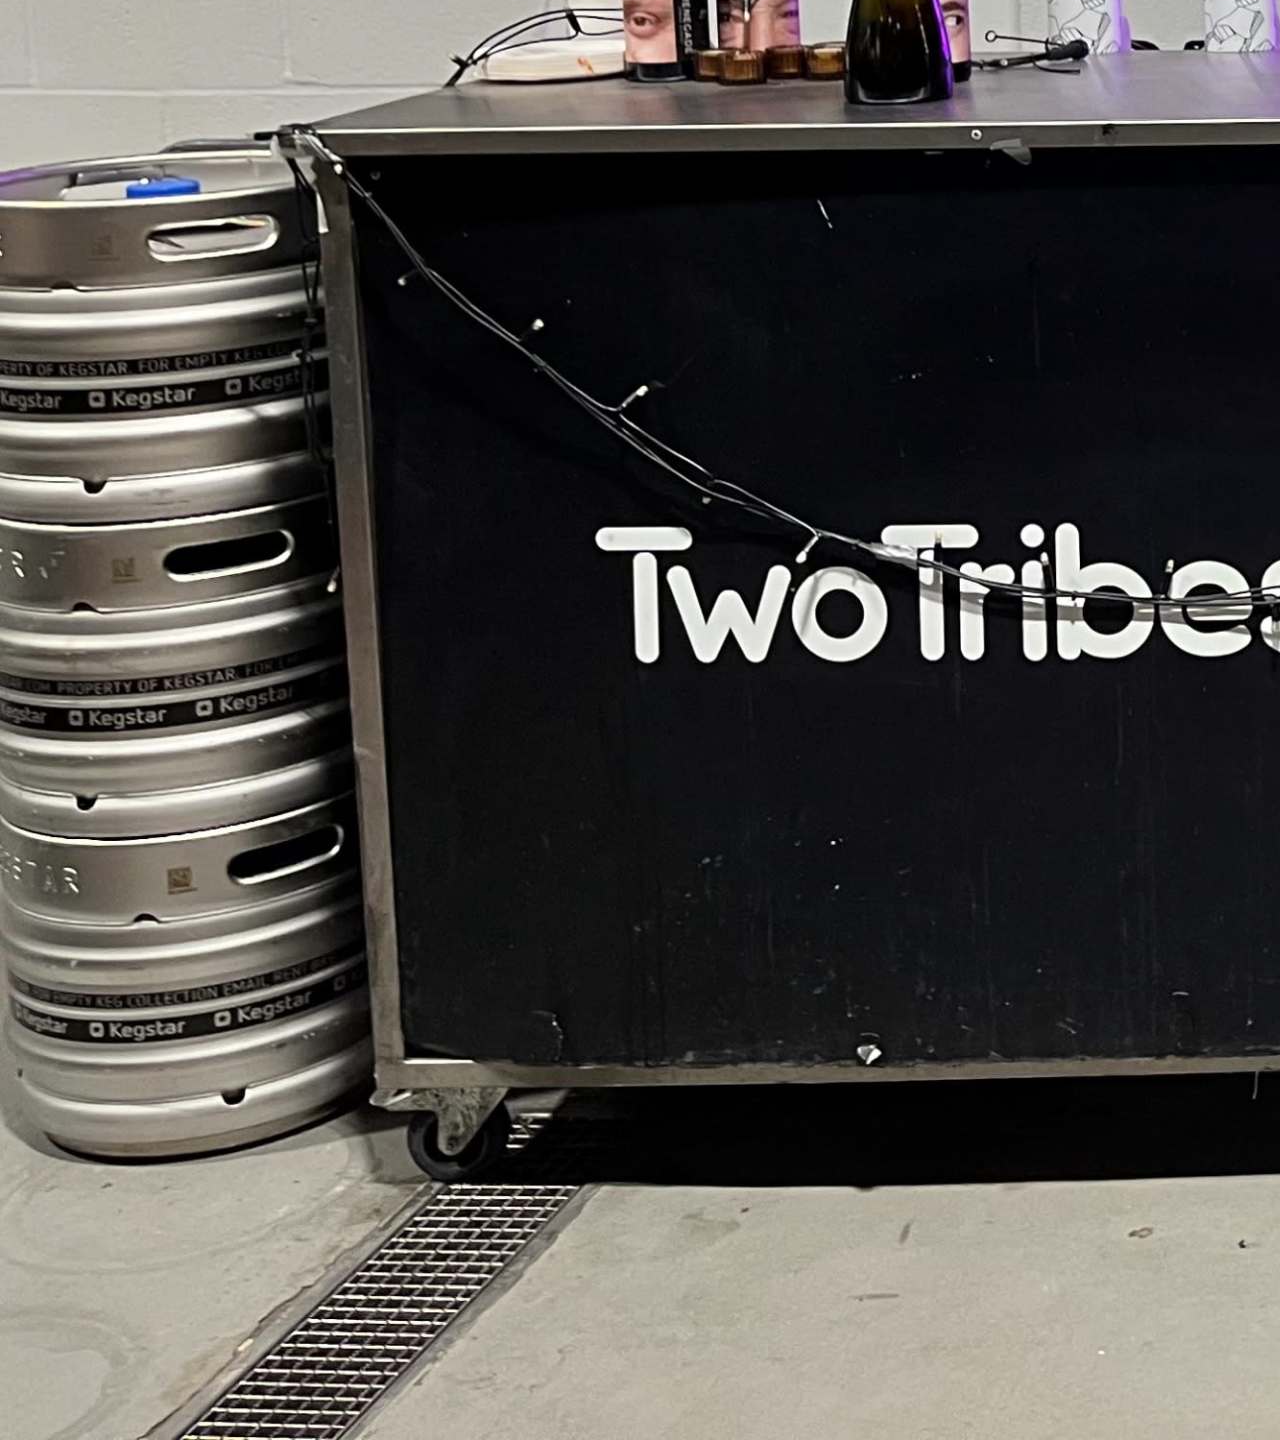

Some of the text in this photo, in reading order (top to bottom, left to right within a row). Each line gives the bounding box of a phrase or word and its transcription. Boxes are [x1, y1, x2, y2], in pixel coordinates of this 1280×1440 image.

[248, 368, 300, 393] Kegst
[112, 386, 196, 409] Kegstar
[136, 678, 158, 692] OF
[219, 685, 294, 714] Kegstar
[88, 708, 167, 729] Kegstar
[127, 986, 218, 1008] COLLECTION
[237, 991, 313, 1023] Kegstar
[109, 1020, 187, 1042] Kegstar
